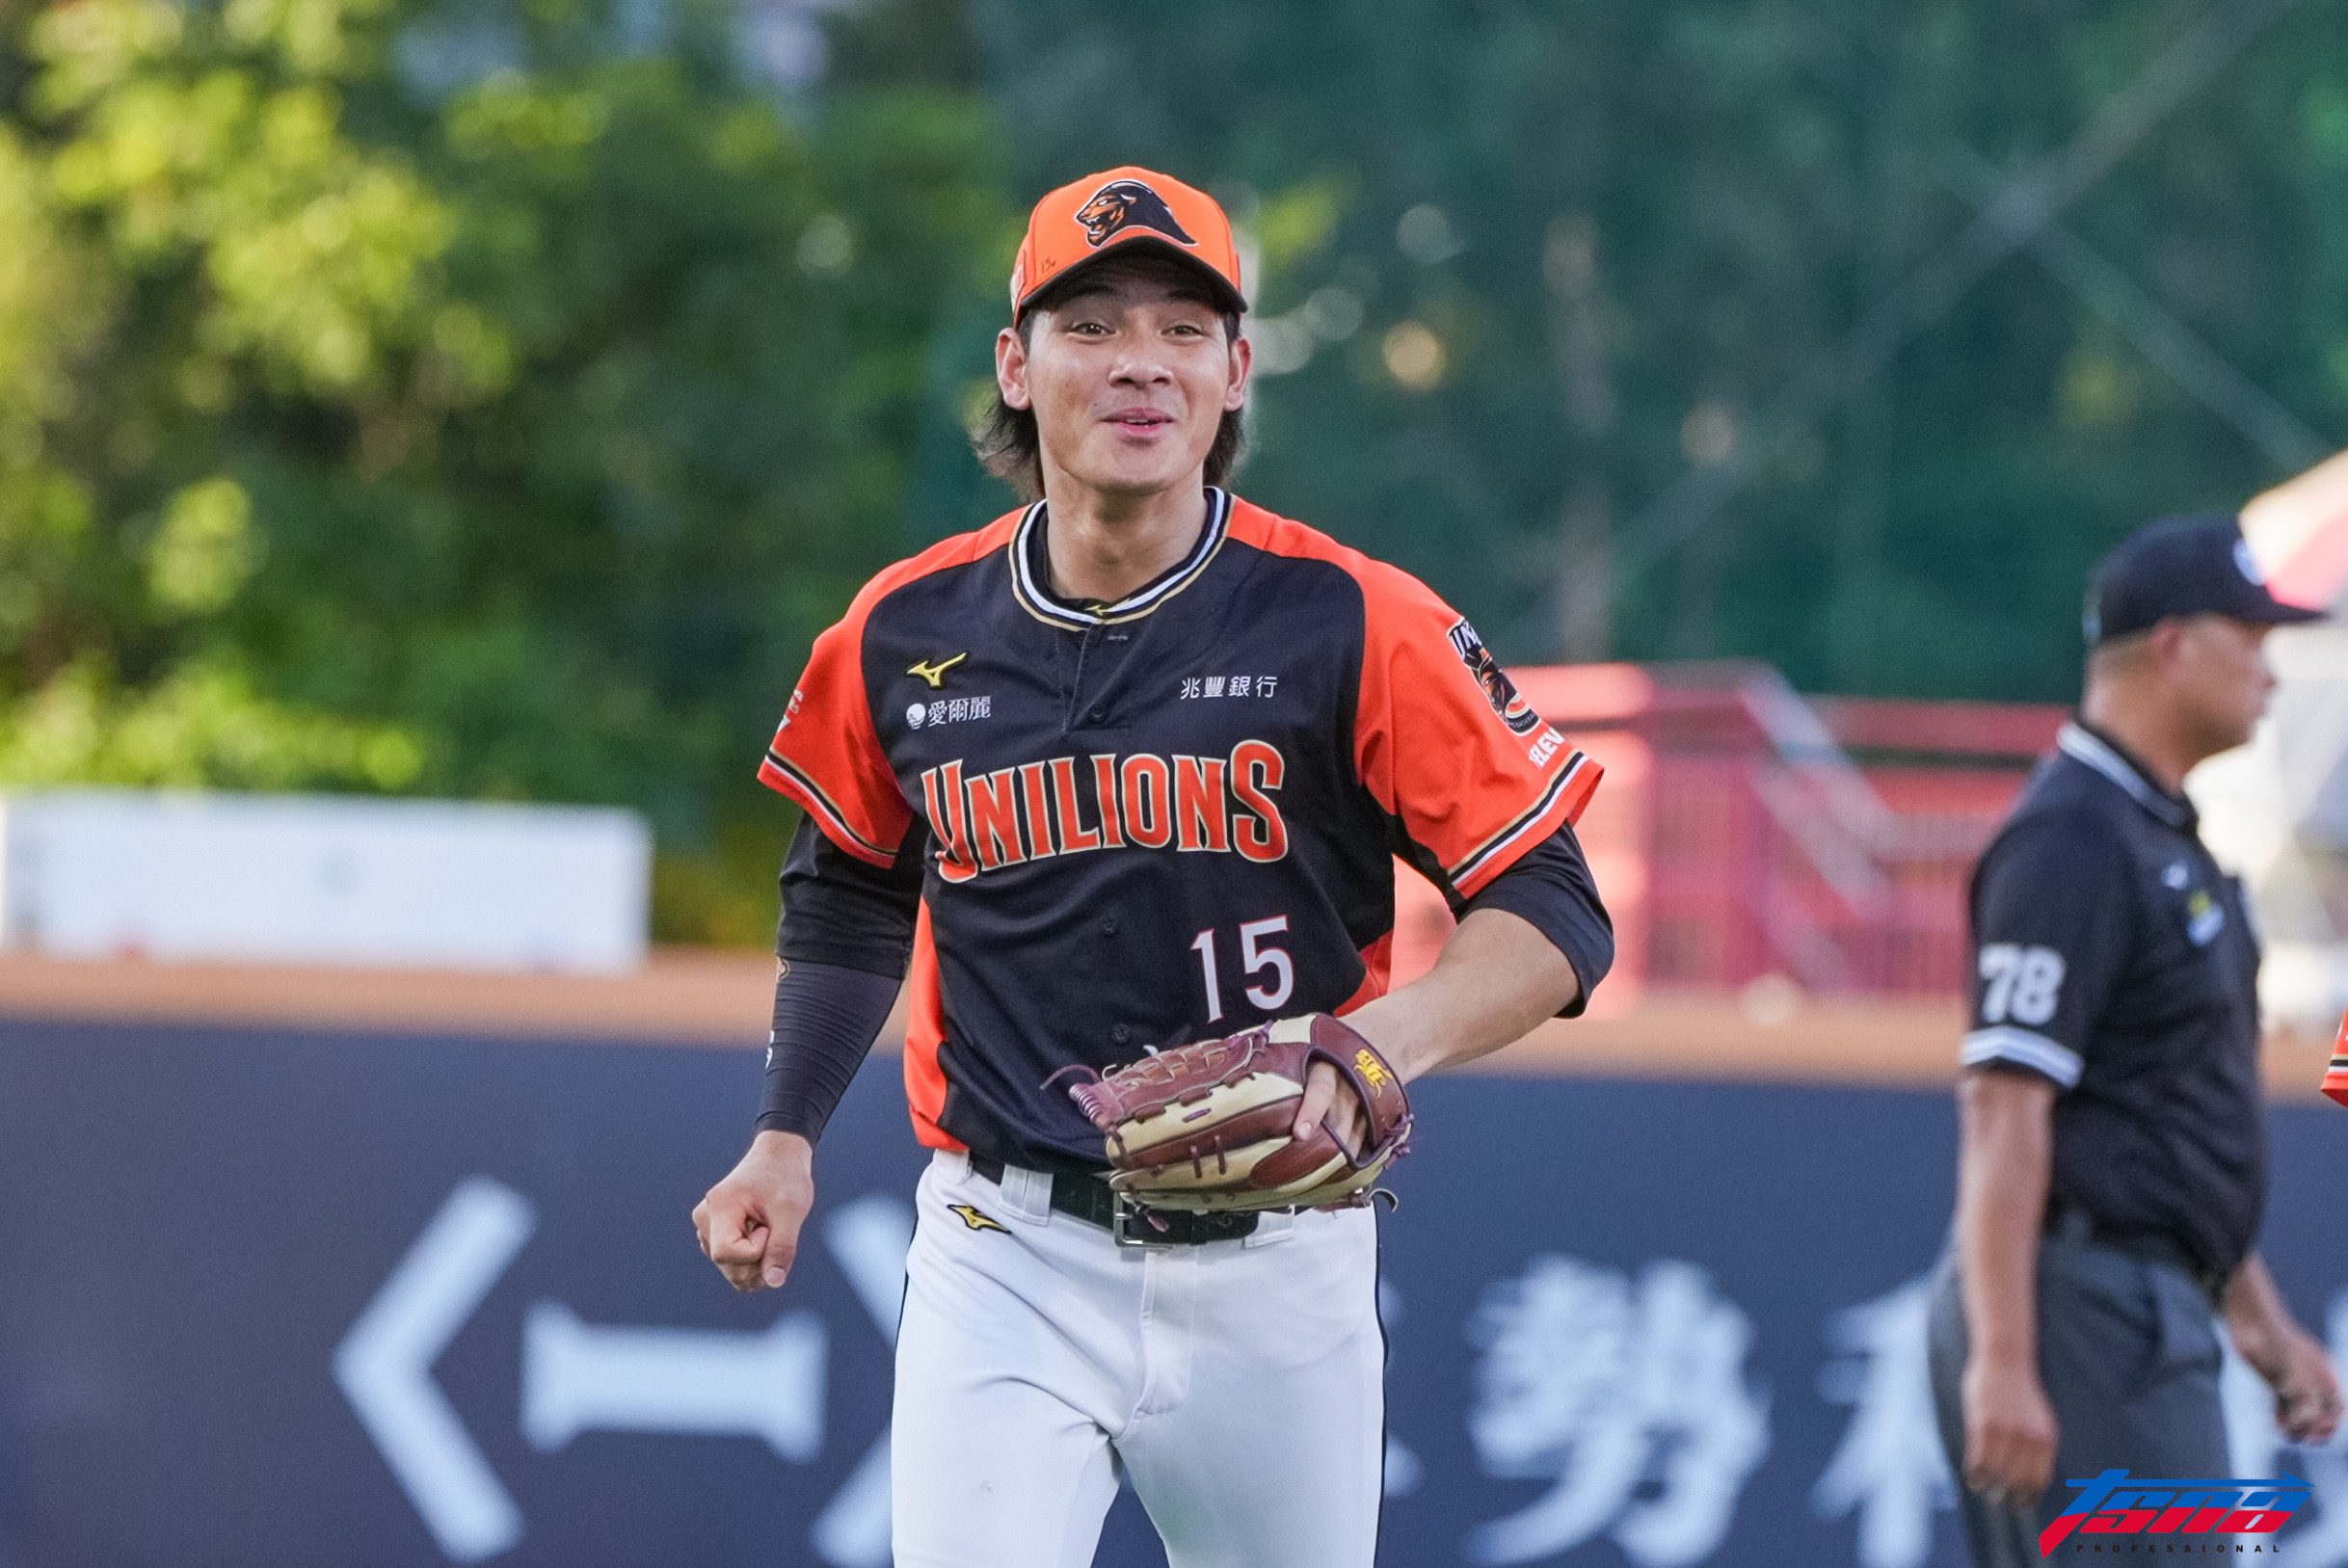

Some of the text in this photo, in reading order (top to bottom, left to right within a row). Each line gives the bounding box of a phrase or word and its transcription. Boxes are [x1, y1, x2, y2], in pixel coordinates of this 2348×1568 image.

[927, 696, 992, 728] 愛爾麗
[1180, 676, 1278, 701] 兆豐銀行
[921, 738, 1290, 884] UNILIONS
[1190, 915, 1294, 1024] 15
[1977, 942, 2067, 1025] 78
